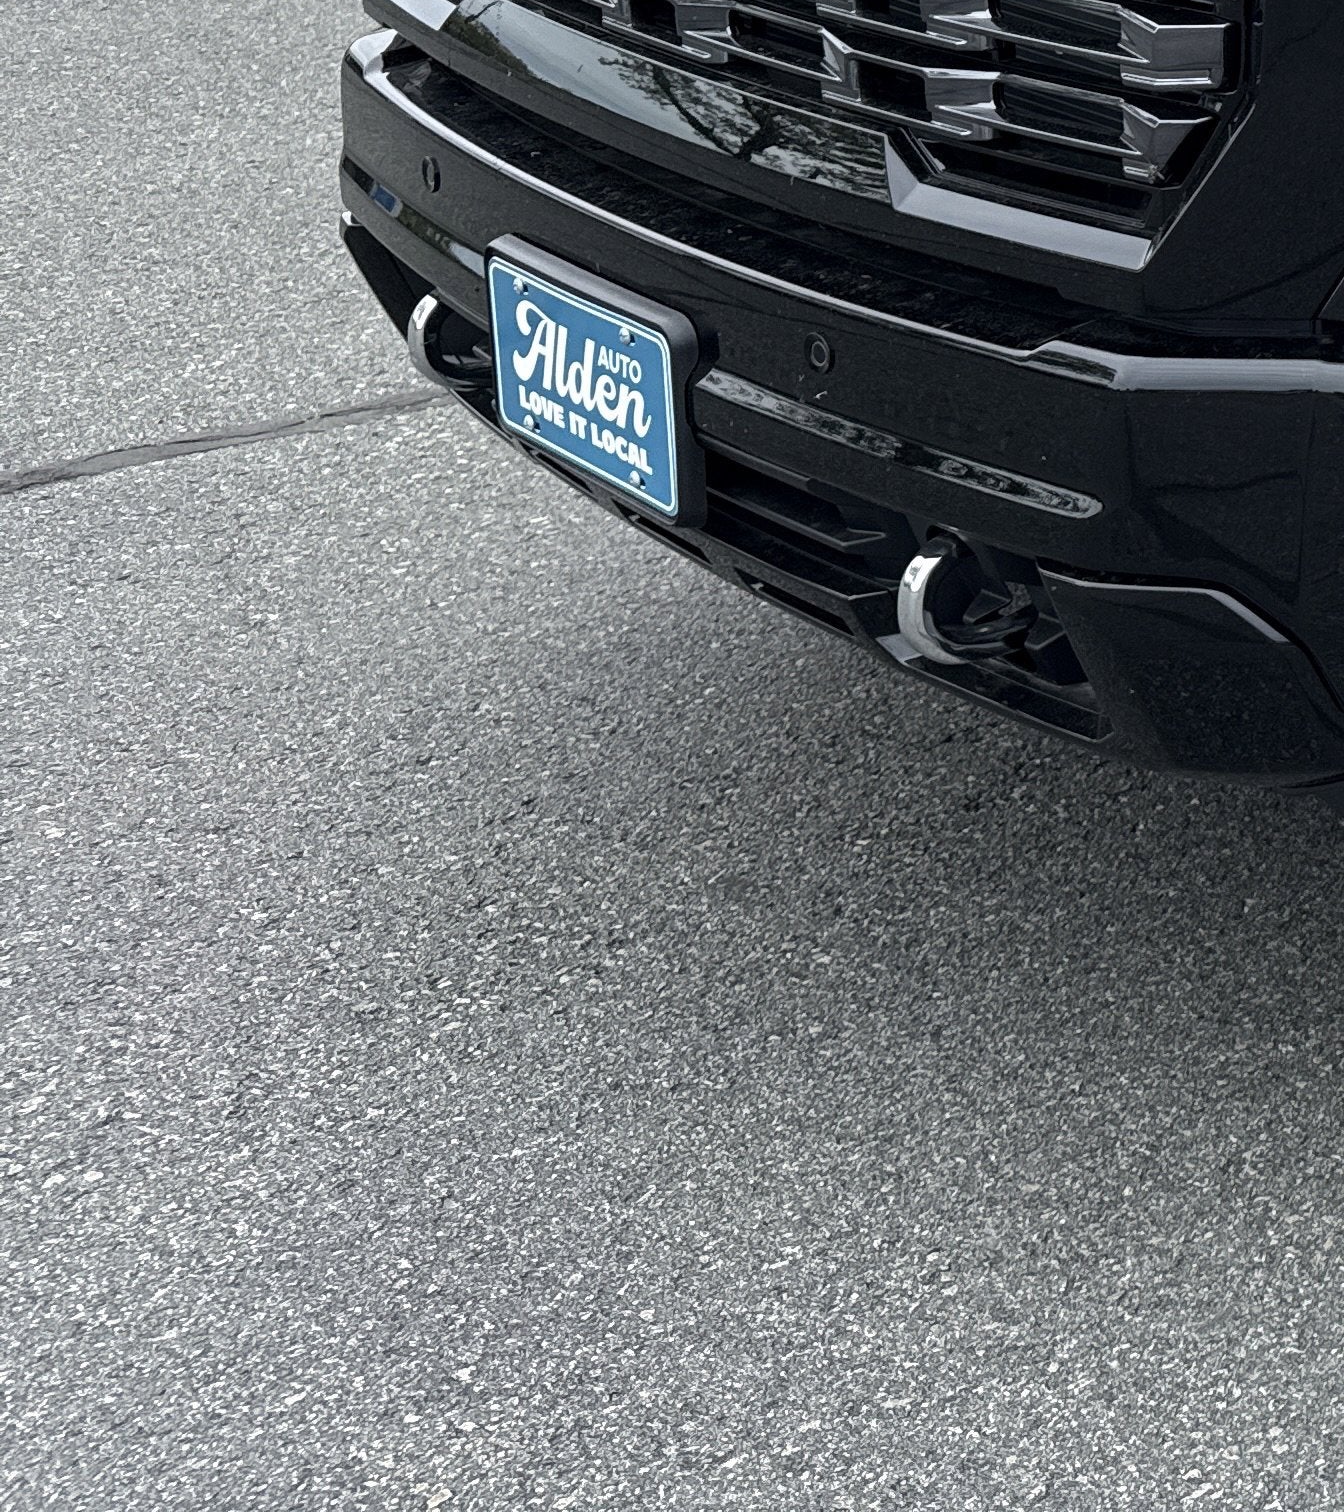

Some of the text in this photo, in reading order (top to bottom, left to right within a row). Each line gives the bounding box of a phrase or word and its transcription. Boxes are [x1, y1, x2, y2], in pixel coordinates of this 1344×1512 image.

[512, 299, 652, 438] Alden
[597, 345, 643, 384] AUTO
[518, 384, 653, 476] LOVE IT LOCAL
